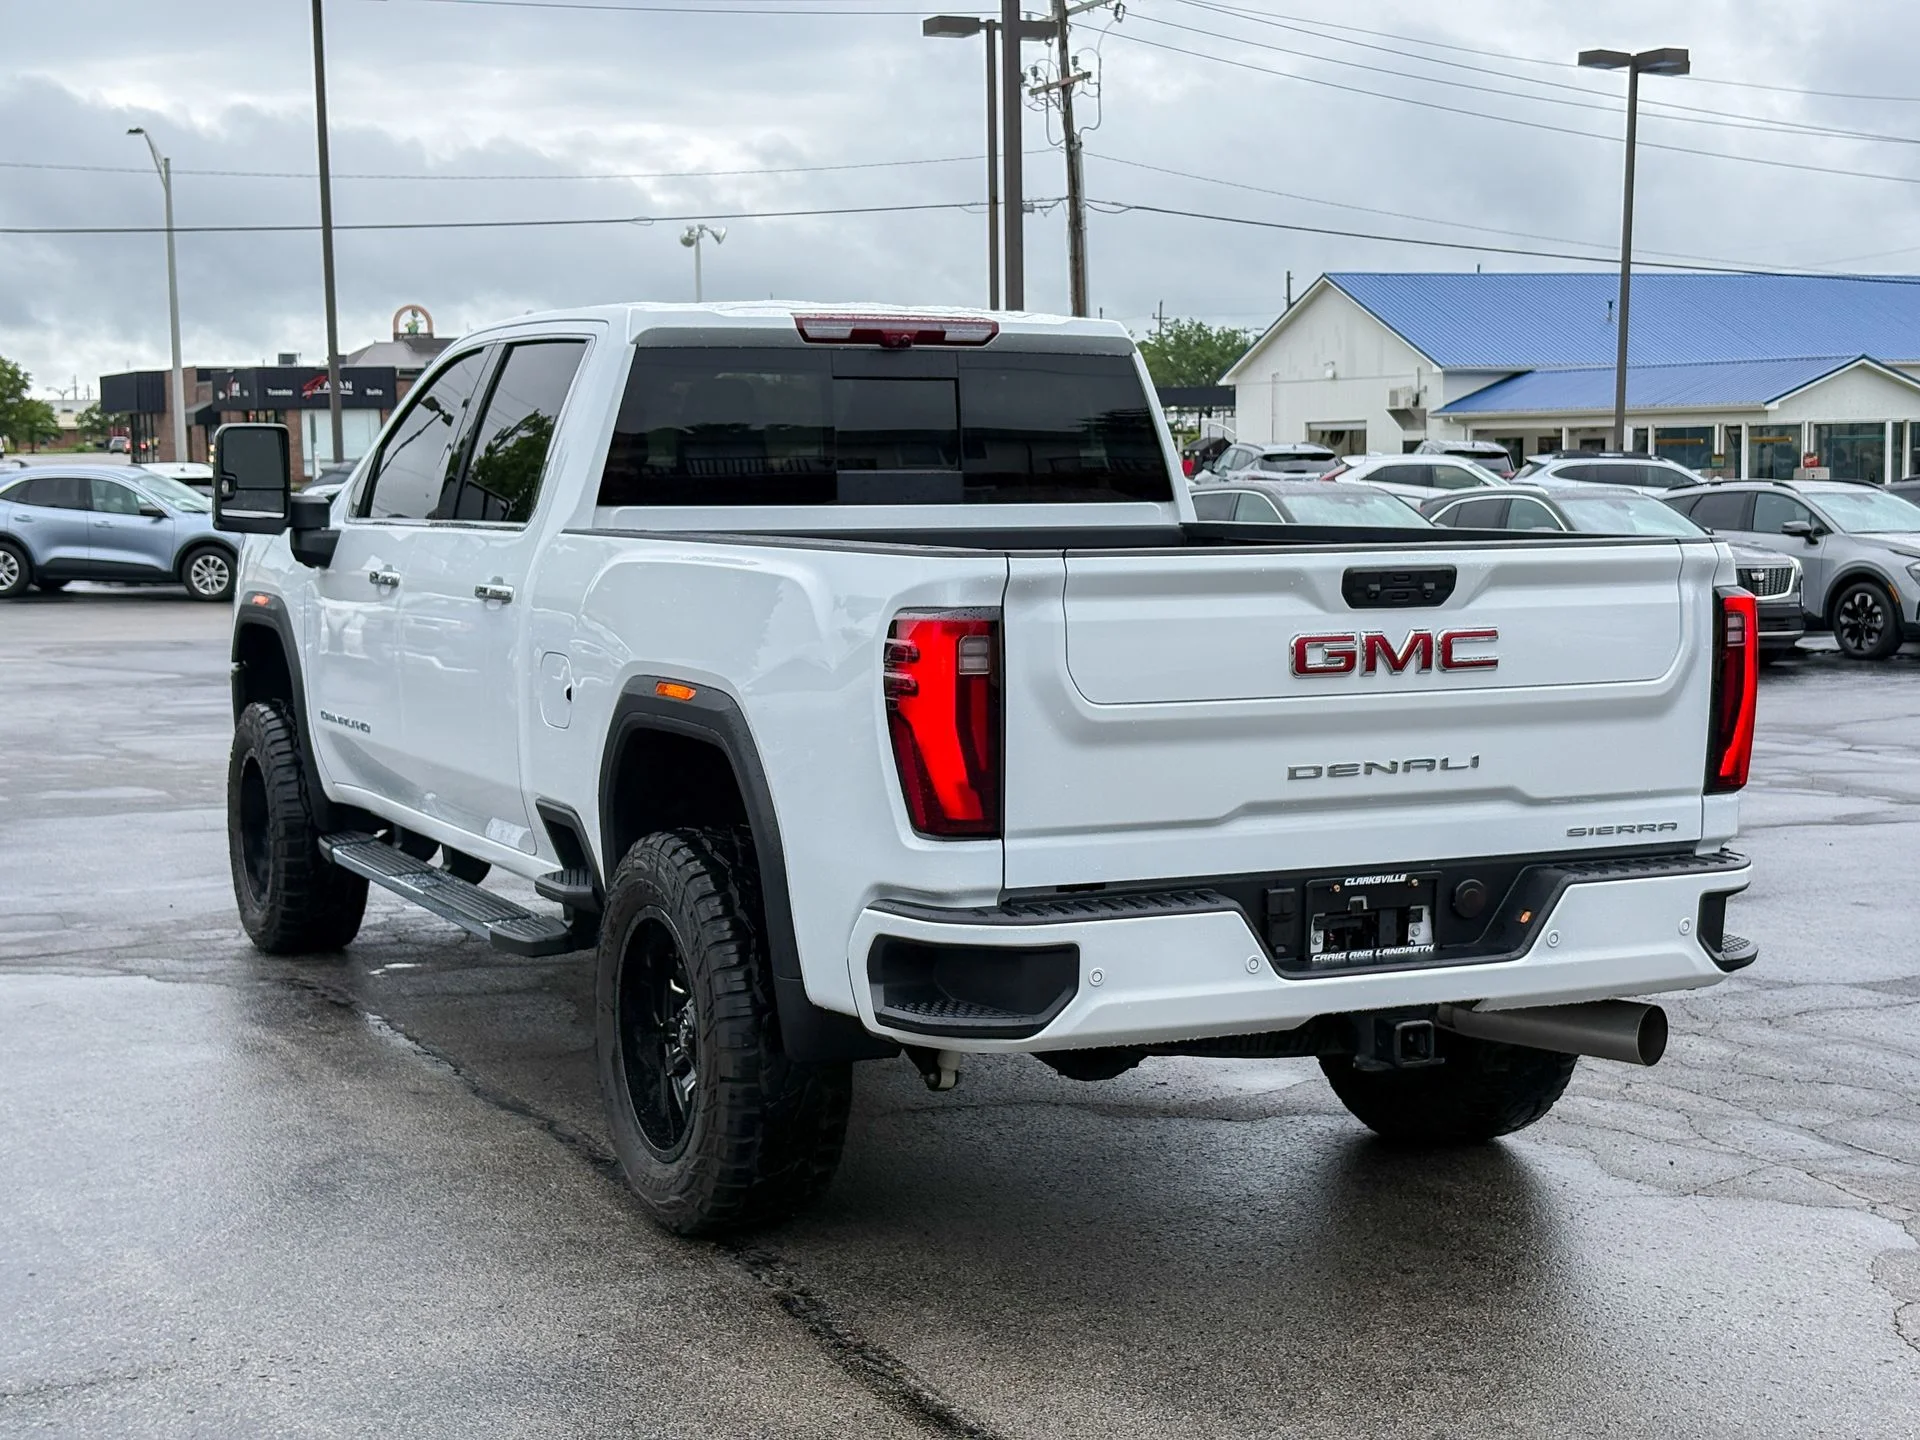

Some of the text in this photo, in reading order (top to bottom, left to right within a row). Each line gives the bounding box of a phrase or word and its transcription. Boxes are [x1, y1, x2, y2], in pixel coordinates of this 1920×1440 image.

[1289, 626, 1499, 678] GMC
[1287, 754, 1479, 780] DENALI
[1566, 821, 1678, 837] SIERRA
[1344, 874, 1407, 886] CLARKSVILLE
[1311, 944, 1434, 962] CRAIG AND LANDRETH
